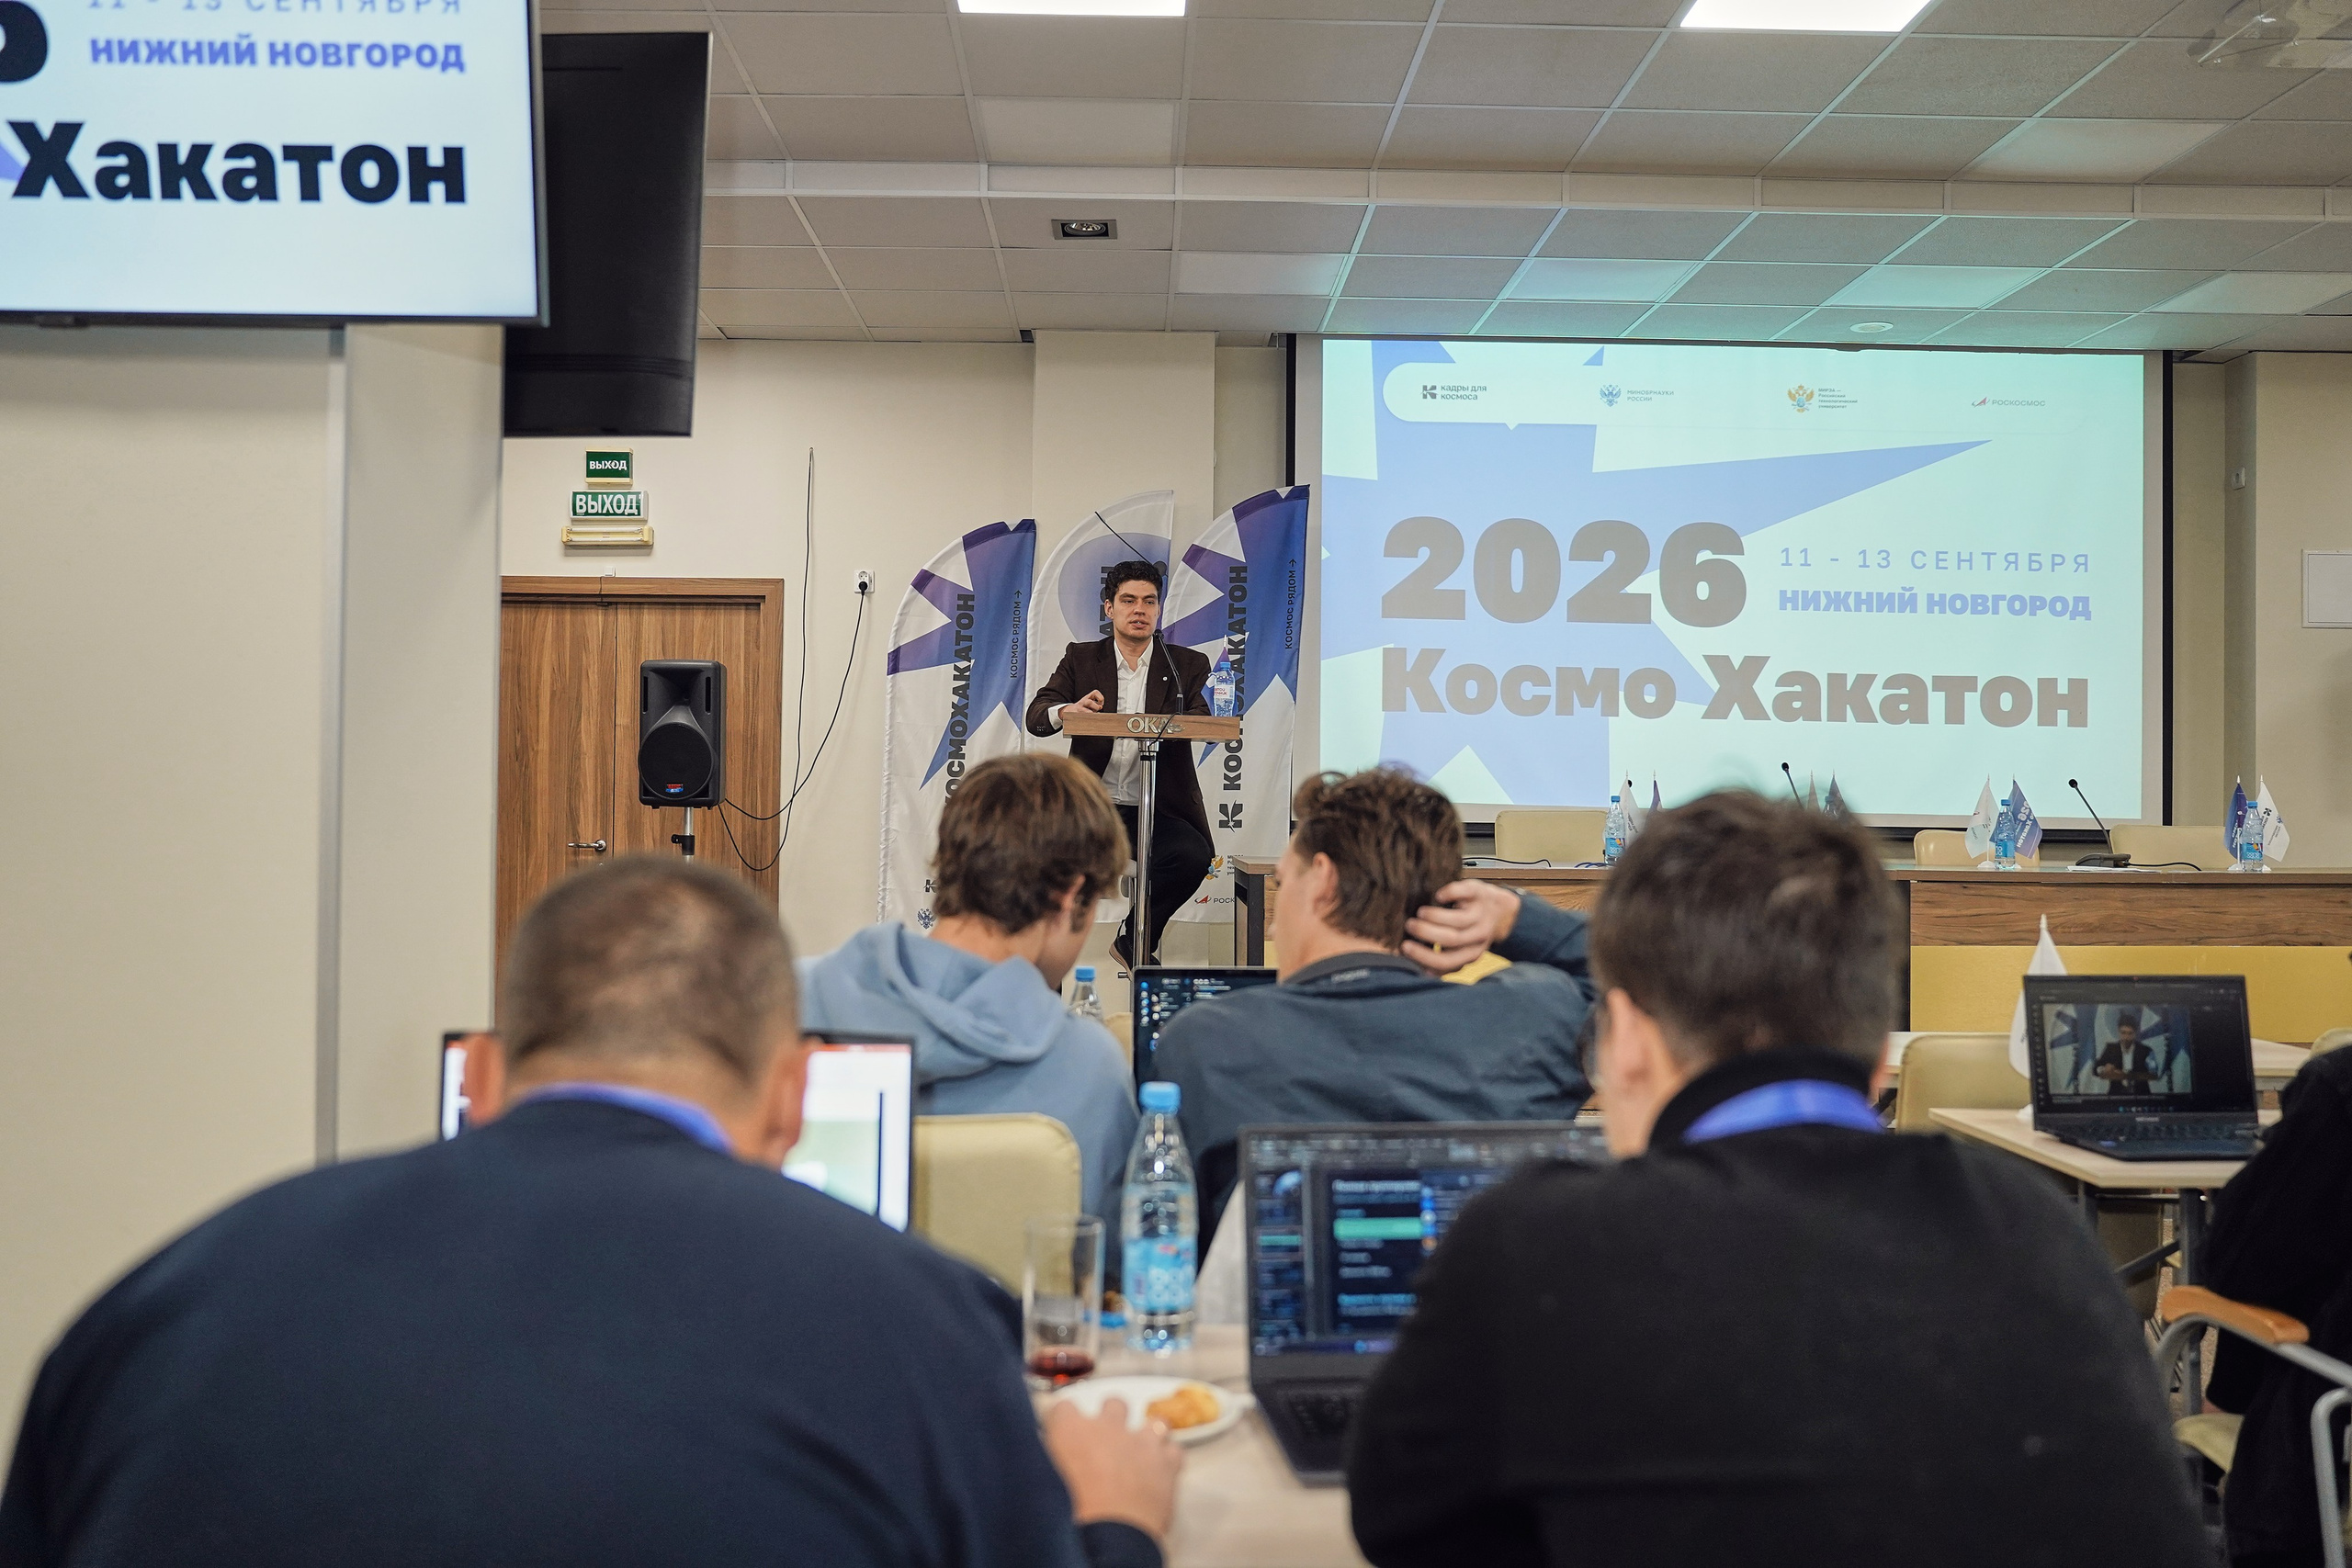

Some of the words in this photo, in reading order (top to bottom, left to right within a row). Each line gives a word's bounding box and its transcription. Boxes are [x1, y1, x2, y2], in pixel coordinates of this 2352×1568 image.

[90, 33, 258, 65] НИЖНИЙ
[268, 39, 466, 73] НОВГОРОД
[6, 119, 468, 204] Хакатон
[1992, 399, 2046, 407] РОСКОСМОС
[589, 460, 628, 470] ВЫХОД
[575, 494, 639, 515] ВЫХОД
[1381, 515, 1747, 627] 2026
[1781, 547, 1812, 567] 11
[1858, 548, 1892, 569] 13
[1910, 549, 2089, 573] СЕНТЯБРЯ
[1287, 570, 1296, 605] РЯДОМ
[1779, 586, 1918, 614] НИЖНИЙ
[1927, 592, 2092, 621] НОВГОРОД
[1013, 600, 1022, 635] РЯДОМ
[1284, 607, 1294, 649] КОСМОС
[1010, 635, 1020, 678] КОСМОС
[1223, 565, 1248, 791] КОСАКАТОН
[1381, 647, 1677, 719] Космо
[1701, 653, 2088, 728] Хакатон
[944, 593, 975, 806] ОСМОХАКАТОН
